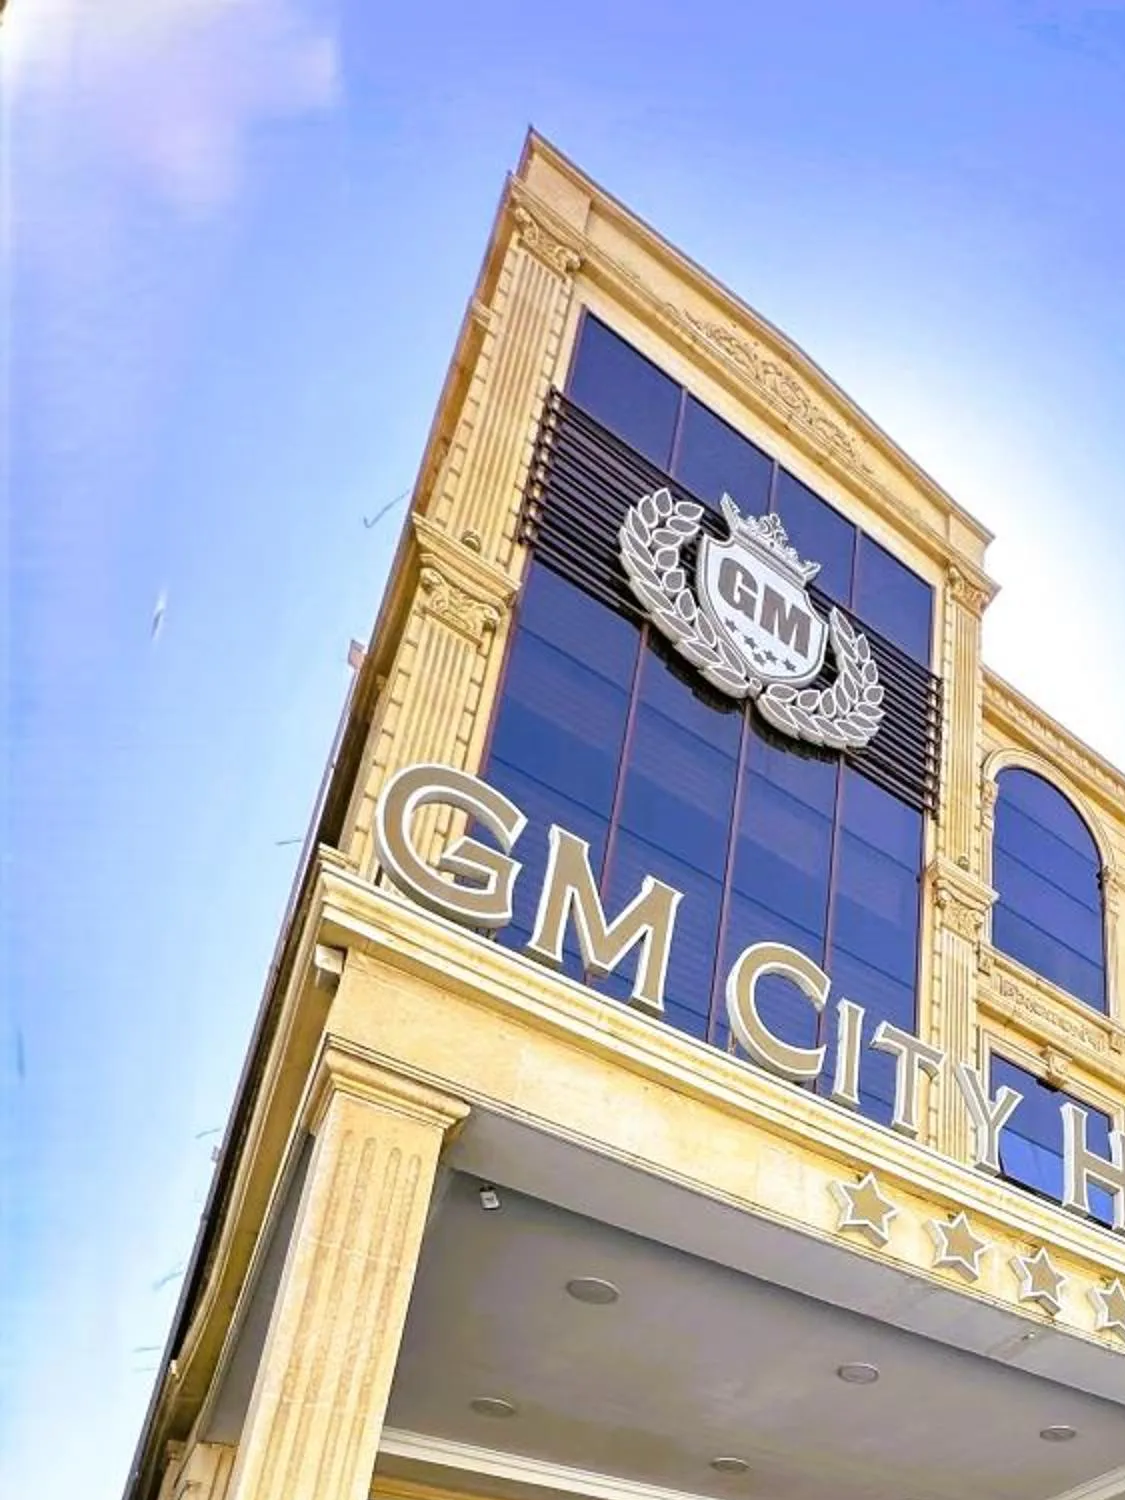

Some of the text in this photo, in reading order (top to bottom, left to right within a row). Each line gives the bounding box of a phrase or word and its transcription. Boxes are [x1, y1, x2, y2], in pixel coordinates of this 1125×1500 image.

[718, 557, 812, 660] GM
[375, 763, 684, 1019] GM
[726, 941, 1023, 1177] CITY
